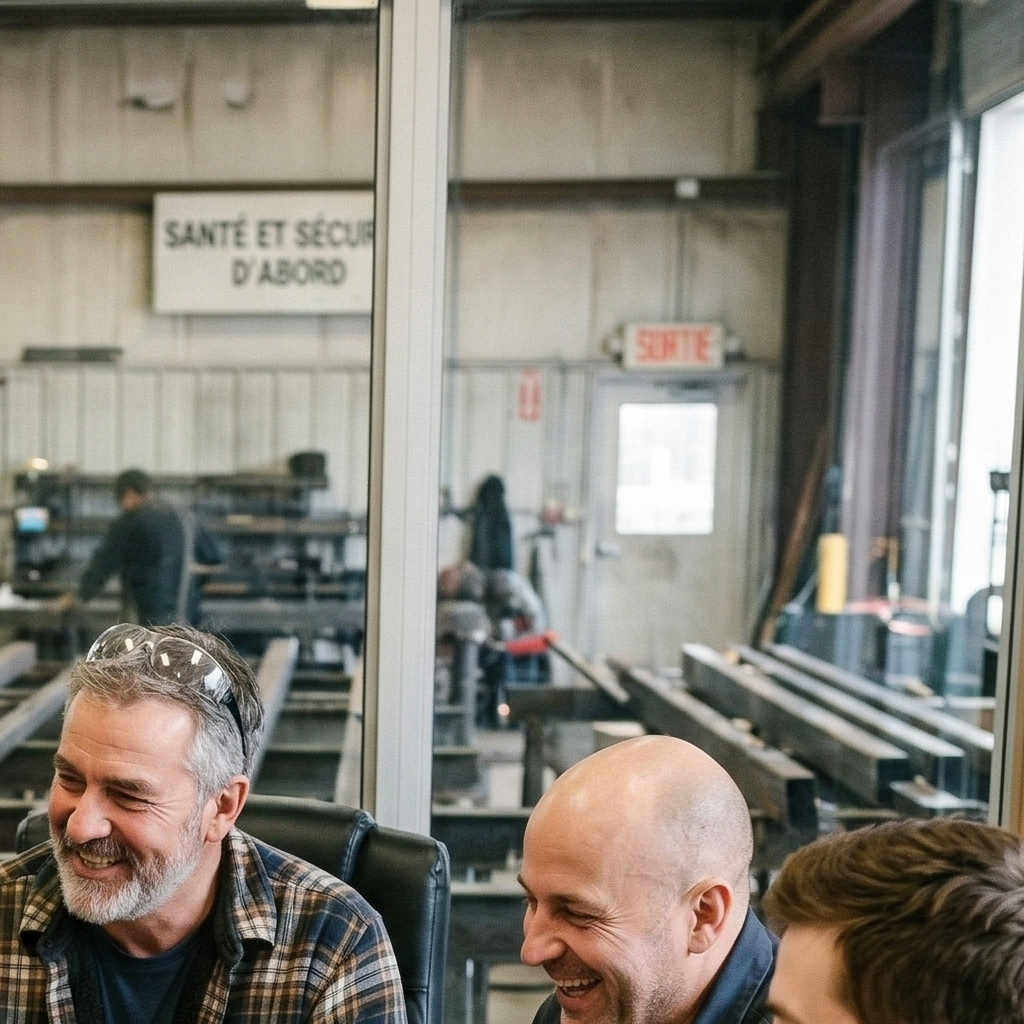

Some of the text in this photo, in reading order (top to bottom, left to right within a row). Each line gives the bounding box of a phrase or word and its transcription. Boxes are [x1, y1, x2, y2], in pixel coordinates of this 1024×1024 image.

[165, 213, 248, 248] SANTÉ
[257, 219, 286, 248] ET
[231, 257, 347, 286] D'ABORD
[635, 327, 712, 364] SORTIE
